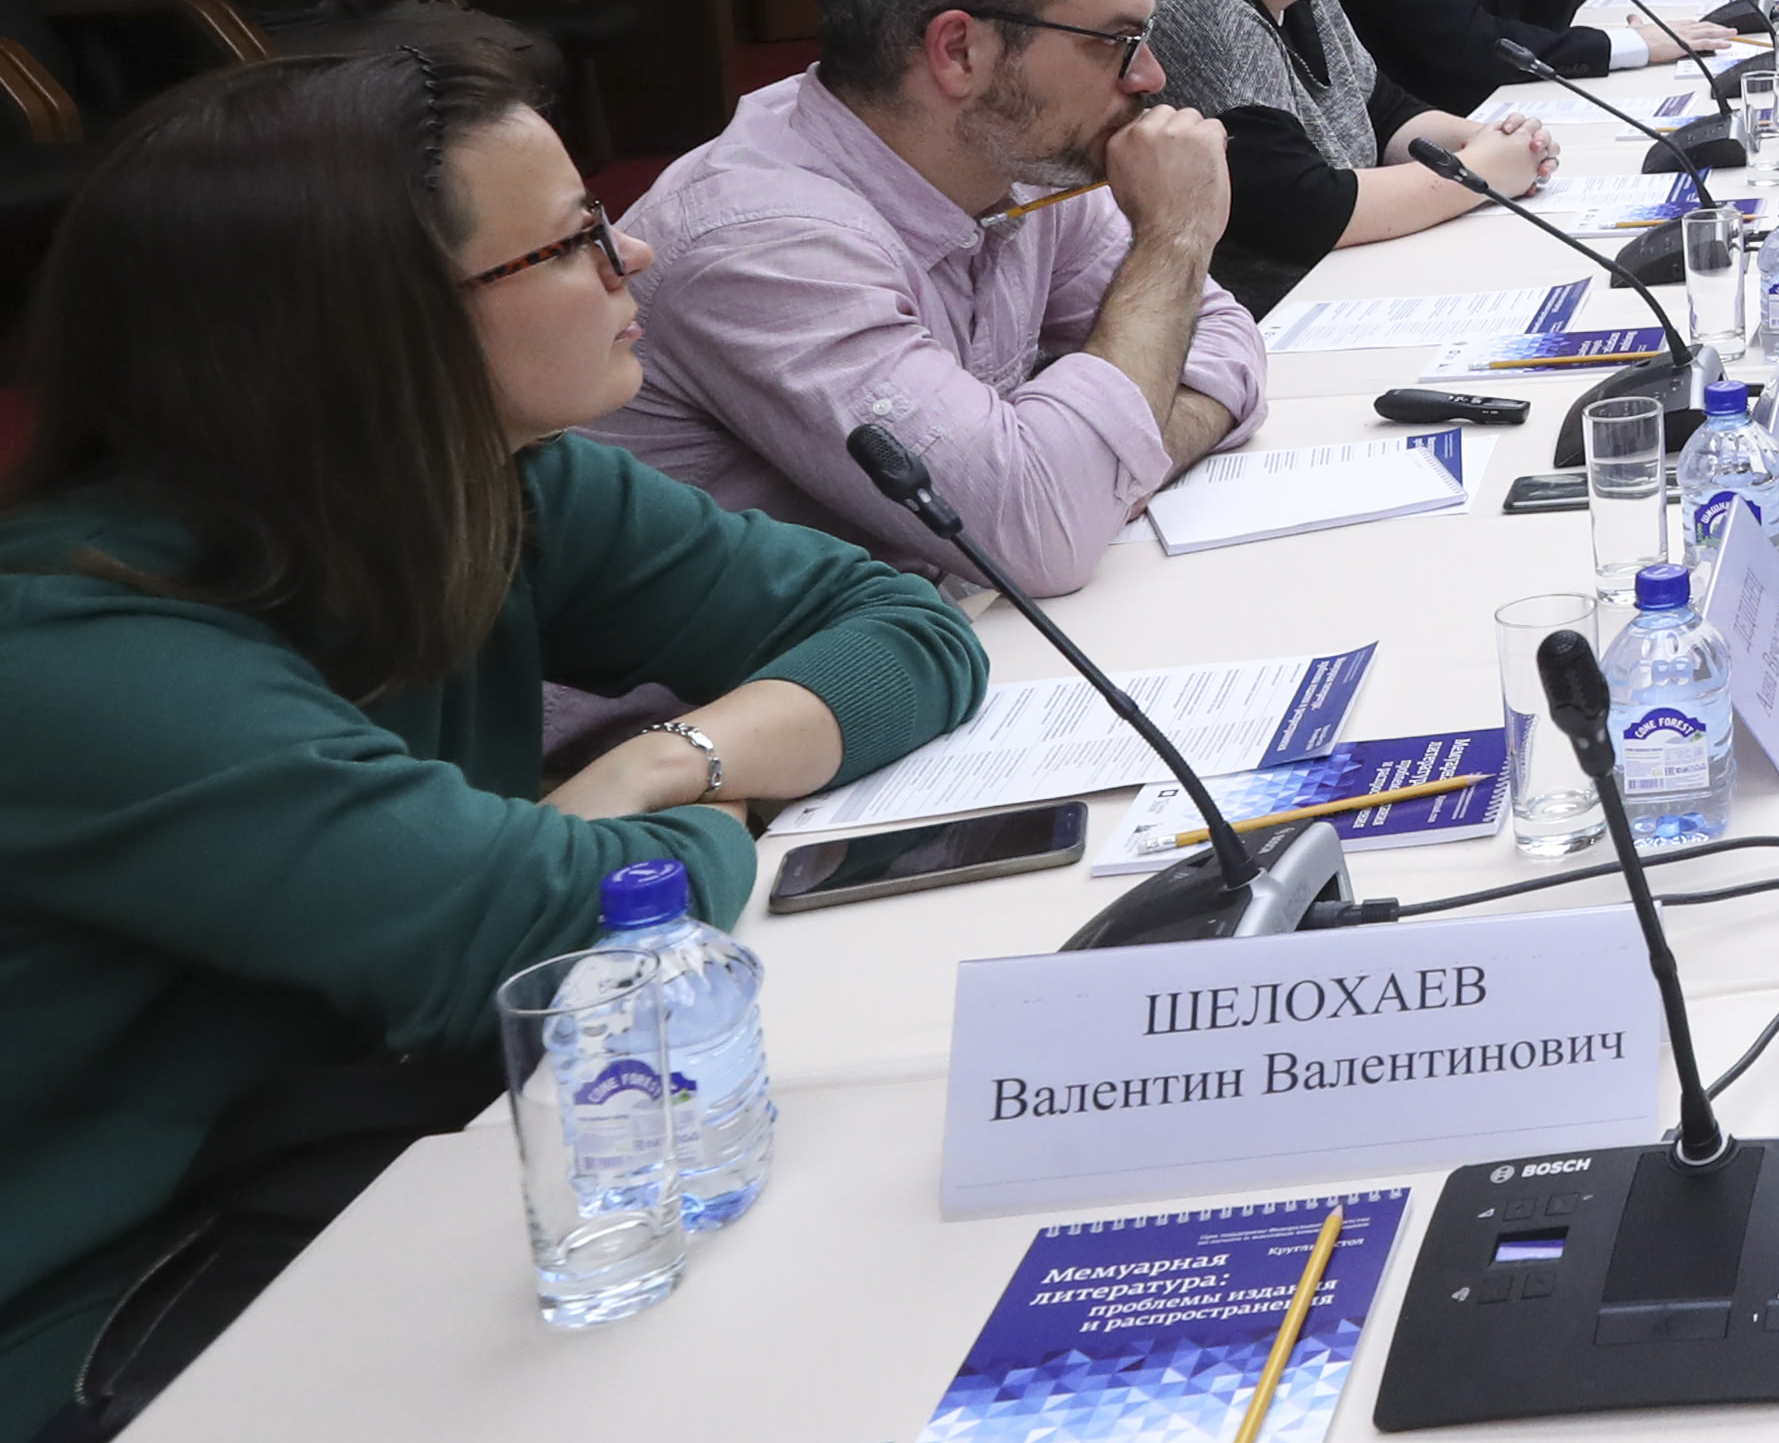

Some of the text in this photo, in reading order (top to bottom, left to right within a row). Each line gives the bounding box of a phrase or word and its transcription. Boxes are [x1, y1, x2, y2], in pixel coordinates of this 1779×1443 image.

[1658, 717, 1694, 734] FOREST
[1144, 965, 1489, 1040] ШЕЛОХАЕВ
[989, 1026, 1627, 1126] Валентин Валентинович
[1521, 1156, 1591, 1179] BOSCH
[1041, 1253, 1229, 1285] Мемуарная
[1030, 1273, 1231, 1307] литература:
[1088, 1293, 1222, 1318] проблемы
[1079, 1319, 1099, 1333] и
